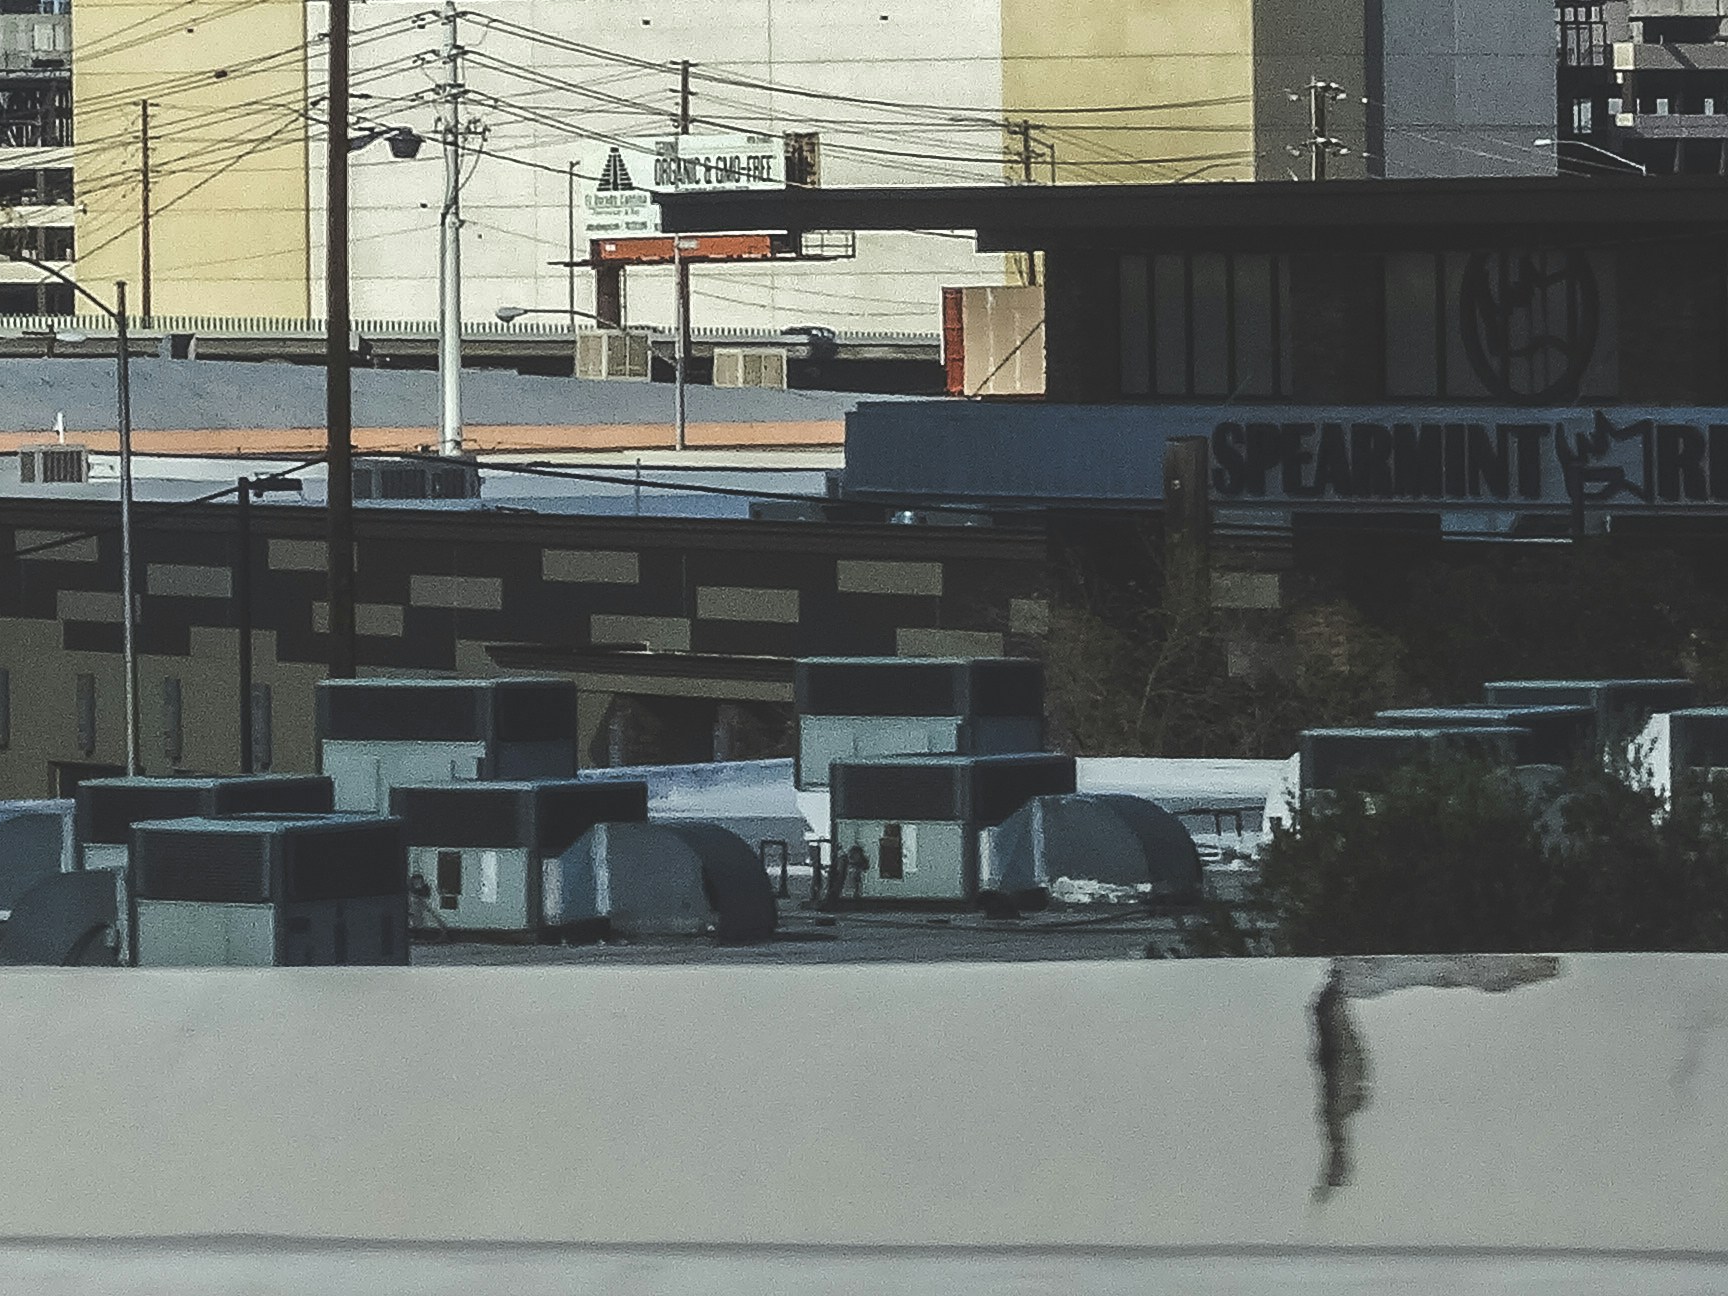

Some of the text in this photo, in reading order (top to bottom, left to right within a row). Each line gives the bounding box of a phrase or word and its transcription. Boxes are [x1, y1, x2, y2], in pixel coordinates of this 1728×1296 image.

[655, 155, 701, 186] ORGANIC
[715, 154, 774, 184] GMO-FREE
[1211, 422, 1551, 500] SPEARMINT
